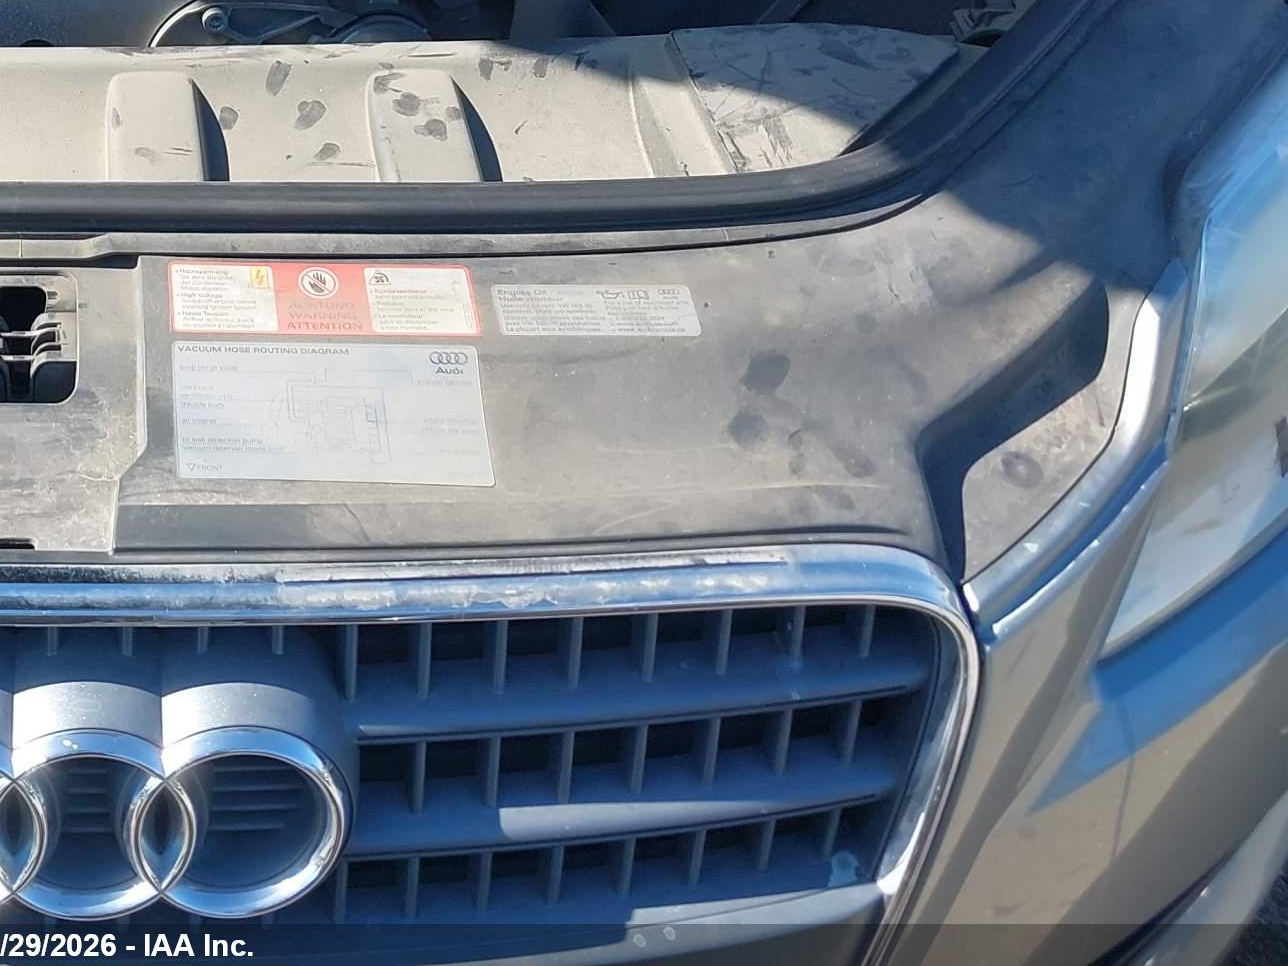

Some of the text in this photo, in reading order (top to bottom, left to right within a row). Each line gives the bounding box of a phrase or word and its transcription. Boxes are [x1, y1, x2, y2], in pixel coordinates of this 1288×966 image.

[288, 301, 354, 310] ACHTUNG
[288, 312, 357, 320] WARNING
[287, 321, 363, 331] ATTENTION
[177, 345, 350, 355] VACUUM HOSE ROUTING DIAGRAM
[435, 366, 465, 375] Audi
[197, 464, 223, 472] FRONT
